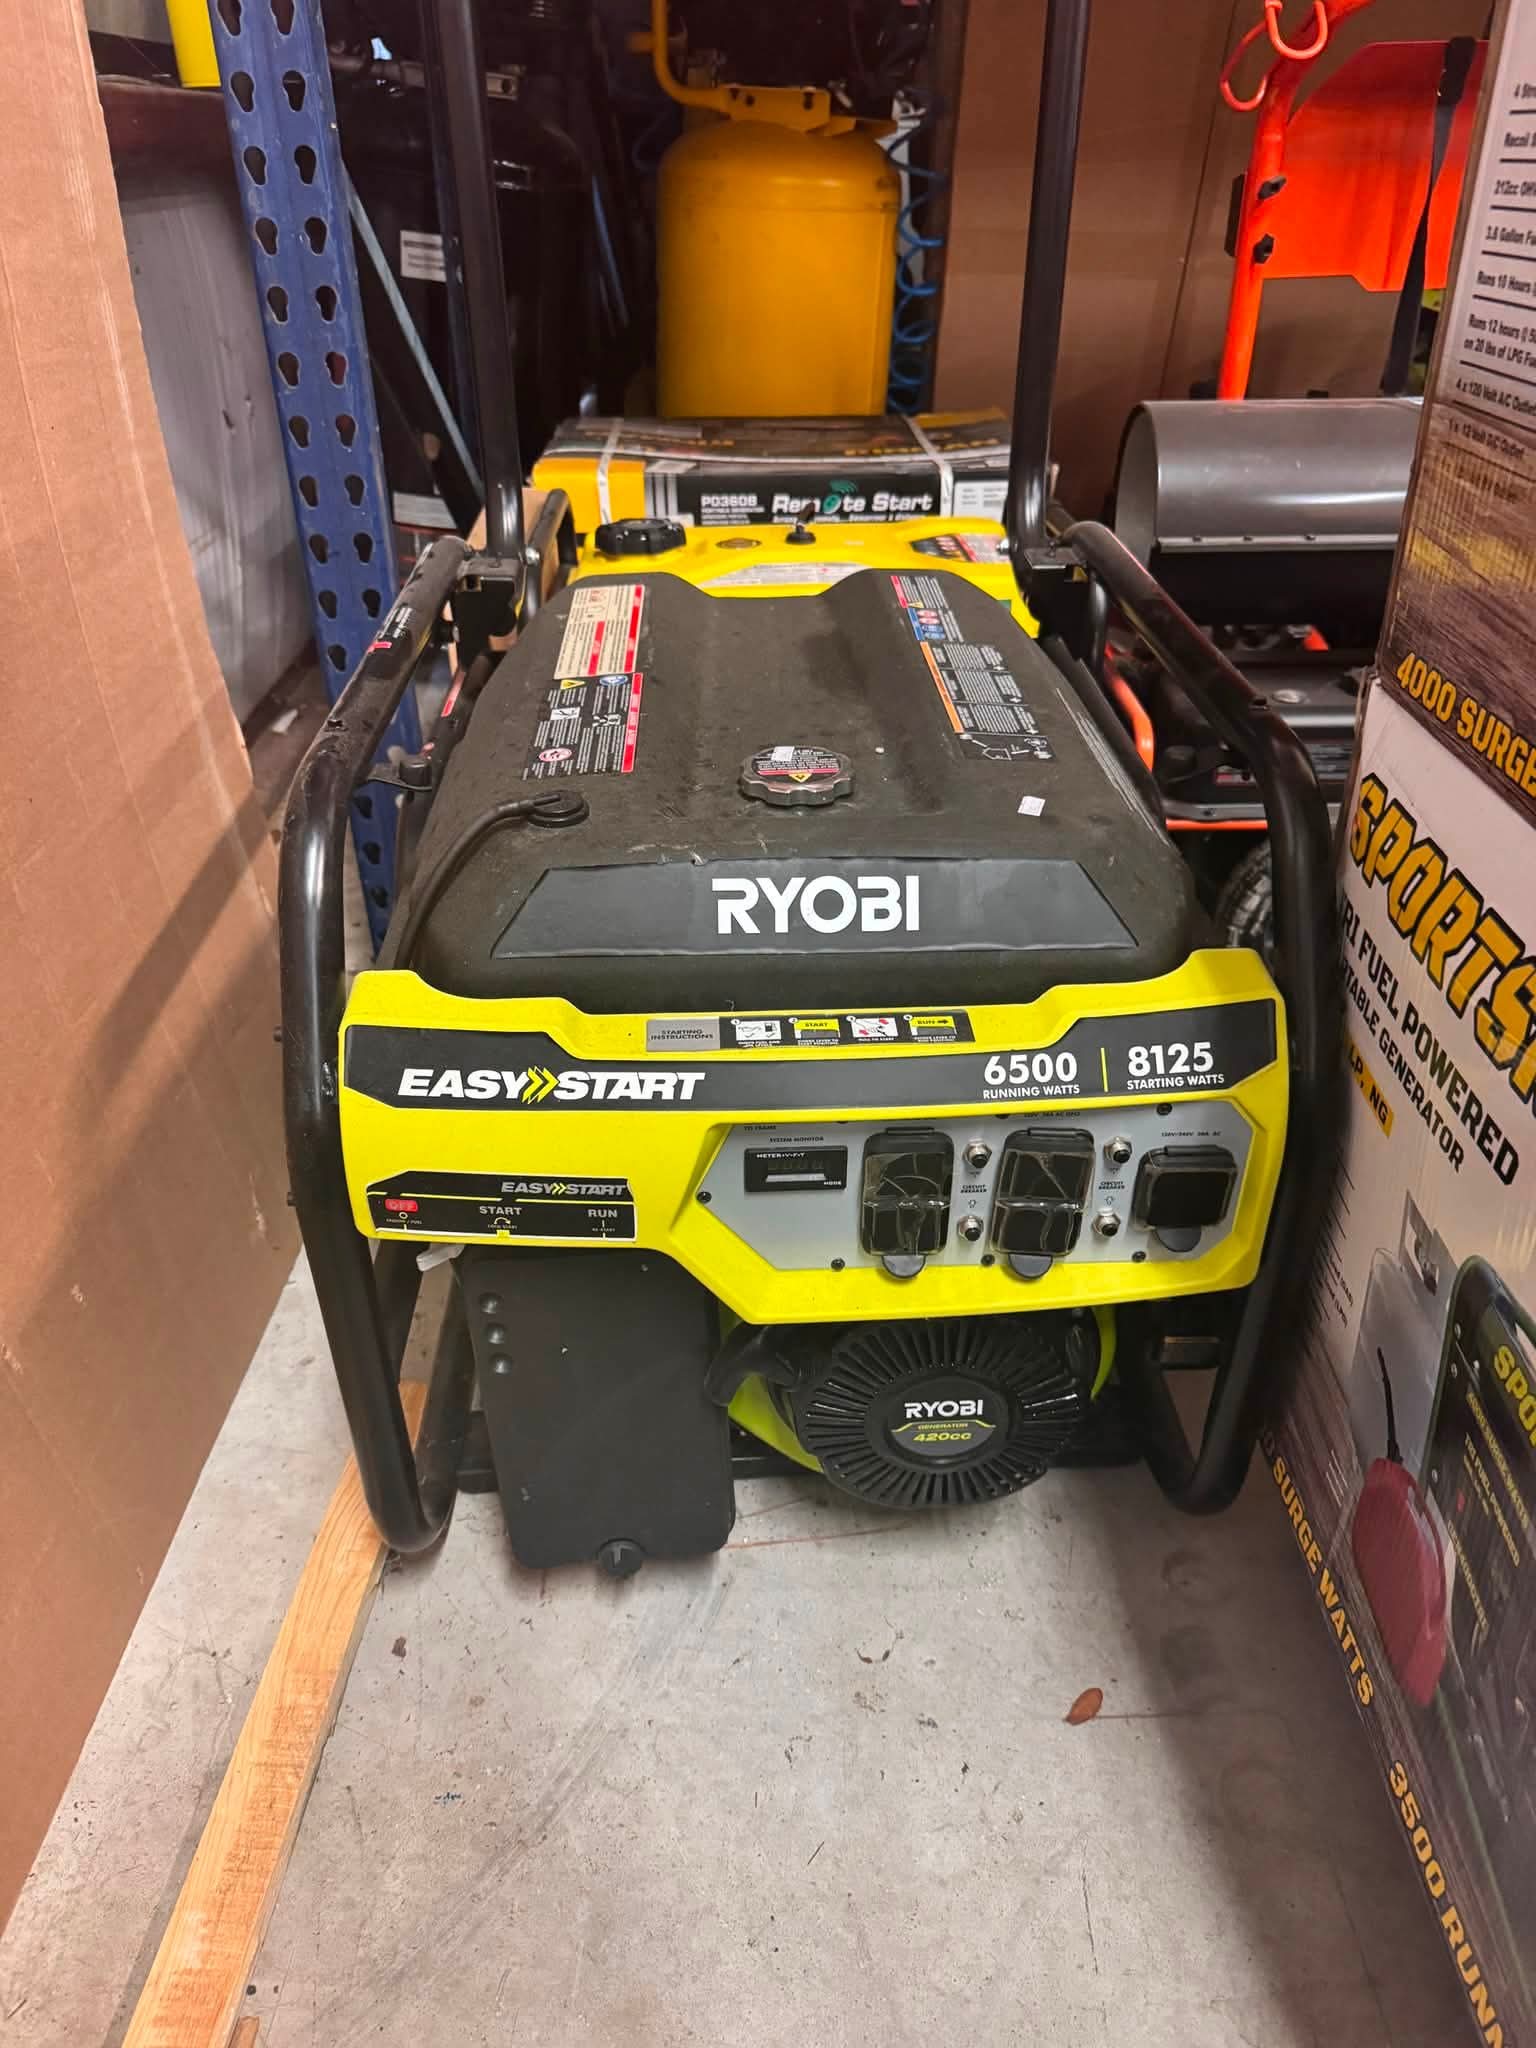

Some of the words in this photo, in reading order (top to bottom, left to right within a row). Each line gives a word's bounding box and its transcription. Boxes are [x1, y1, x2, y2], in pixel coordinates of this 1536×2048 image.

[1499, 226, 1525, 246] Gallon
[1477, 270, 1495, 287] Runs
[1507, 275, 1531, 294] Hours
[1469, 313, 1486, 331] Runs
[1488, 318, 1498, 334] 12
[1499, 320, 1520, 340] hours
[1497, 345, 1507, 359] of
[1507, 346, 1524, 364] LPG
[1469, 382, 1482, 399] 120
[1483, 385, 1499, 403] Volt
[871, 491, 933, 513] Start
[1396, 652, 1457, 723] 4000
[711, 874, 921, 935] RYOBI
[650, 1033, 714, 1041] INSTRUCTIONS
[983, 1051, 1078, 1086] 6500
[1127, 1041, 1215, 1078] 8125
[1358, 928, 1400, 1021] FUEL
[1401, 1000, 1520, 1186] POWERED
[398, 1067, 526, 1101] EASY
[556, 1070, 706, 1101] START
[983, 1086, 1041, 1100] RUNNING
[1042, 1084, 1081, 1097] WATTS
[1127, 1077, 1184, 1091] STARTING
[1187, 1073, 1225, 1086] WATTS
[1369, 1084, 1389, 1126] NG
[1378, 1026, 1466, 1174] GENERATOR
[769, 1136, 793, 1144] SYSTEM
[793, 1135, 825, 1143] MONITOR
[501, 1181, 555, 1194] EASY
[564, 1183, 628, 1196] START
[388, 1199, 416, 1212] OFF
[479, 1205, 522, 1216] START
[587, 1208, 618, 1219] RUN
[1494, 1344, 1536, 1447] SPO
[904, 1399, 984, 1419] RYOBI
[1271, 1455, 1324, 1575] SURGE
[1318, 1566, 1376, 1707] WATTS
[1388, 1760, 1447, 1900] 3500
